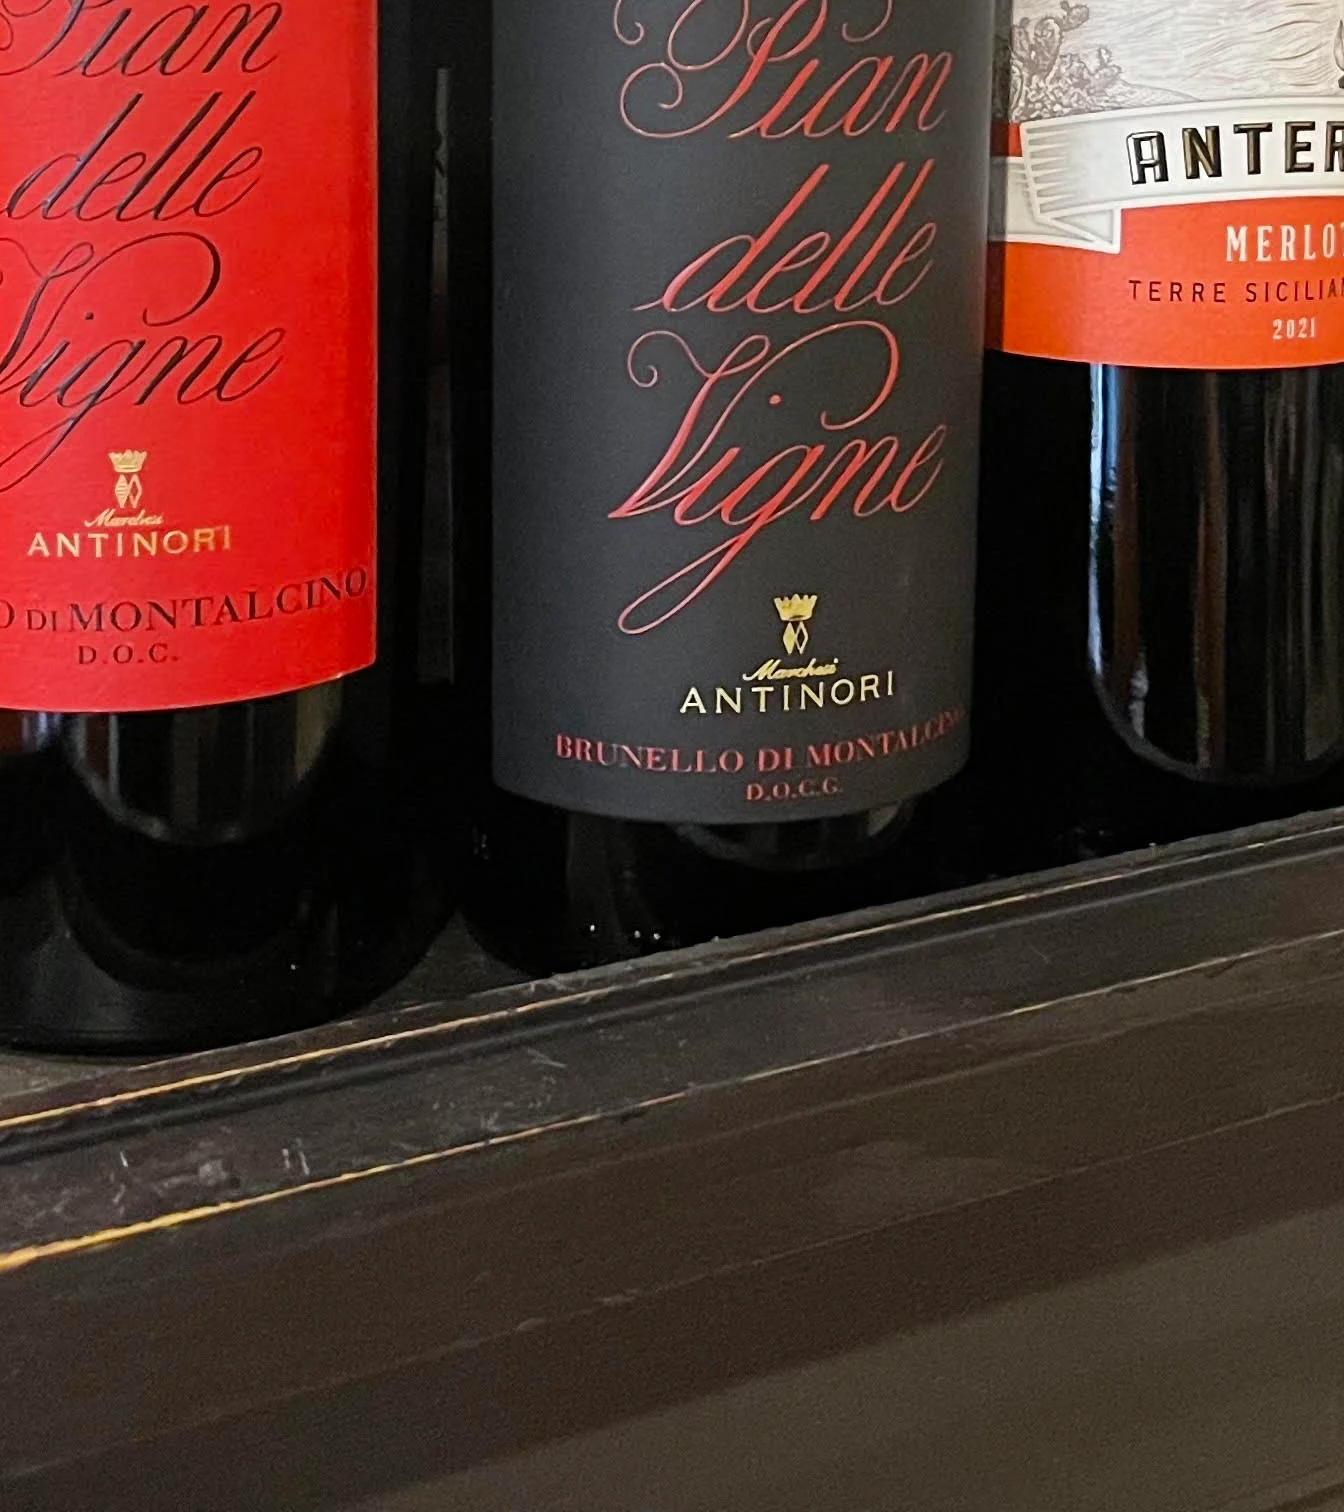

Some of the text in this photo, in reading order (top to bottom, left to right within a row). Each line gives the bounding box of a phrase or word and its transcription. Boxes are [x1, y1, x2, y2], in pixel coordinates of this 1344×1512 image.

[633, 158, 937, 314] delle
[1128, 279, 1227, 303] TERRE
[1272, 317, 1316, 340] 2021
[608, 320, 947, 635] Vigne
[27, 525, 233, 558] ANTINORI
[67, 565, 369, 633] MONTALCINO
[679, 670, 894, 715] ANTINORI
[556, 732, 745, 774] BRUNELLO
[757, 746, 794, 773] DI
